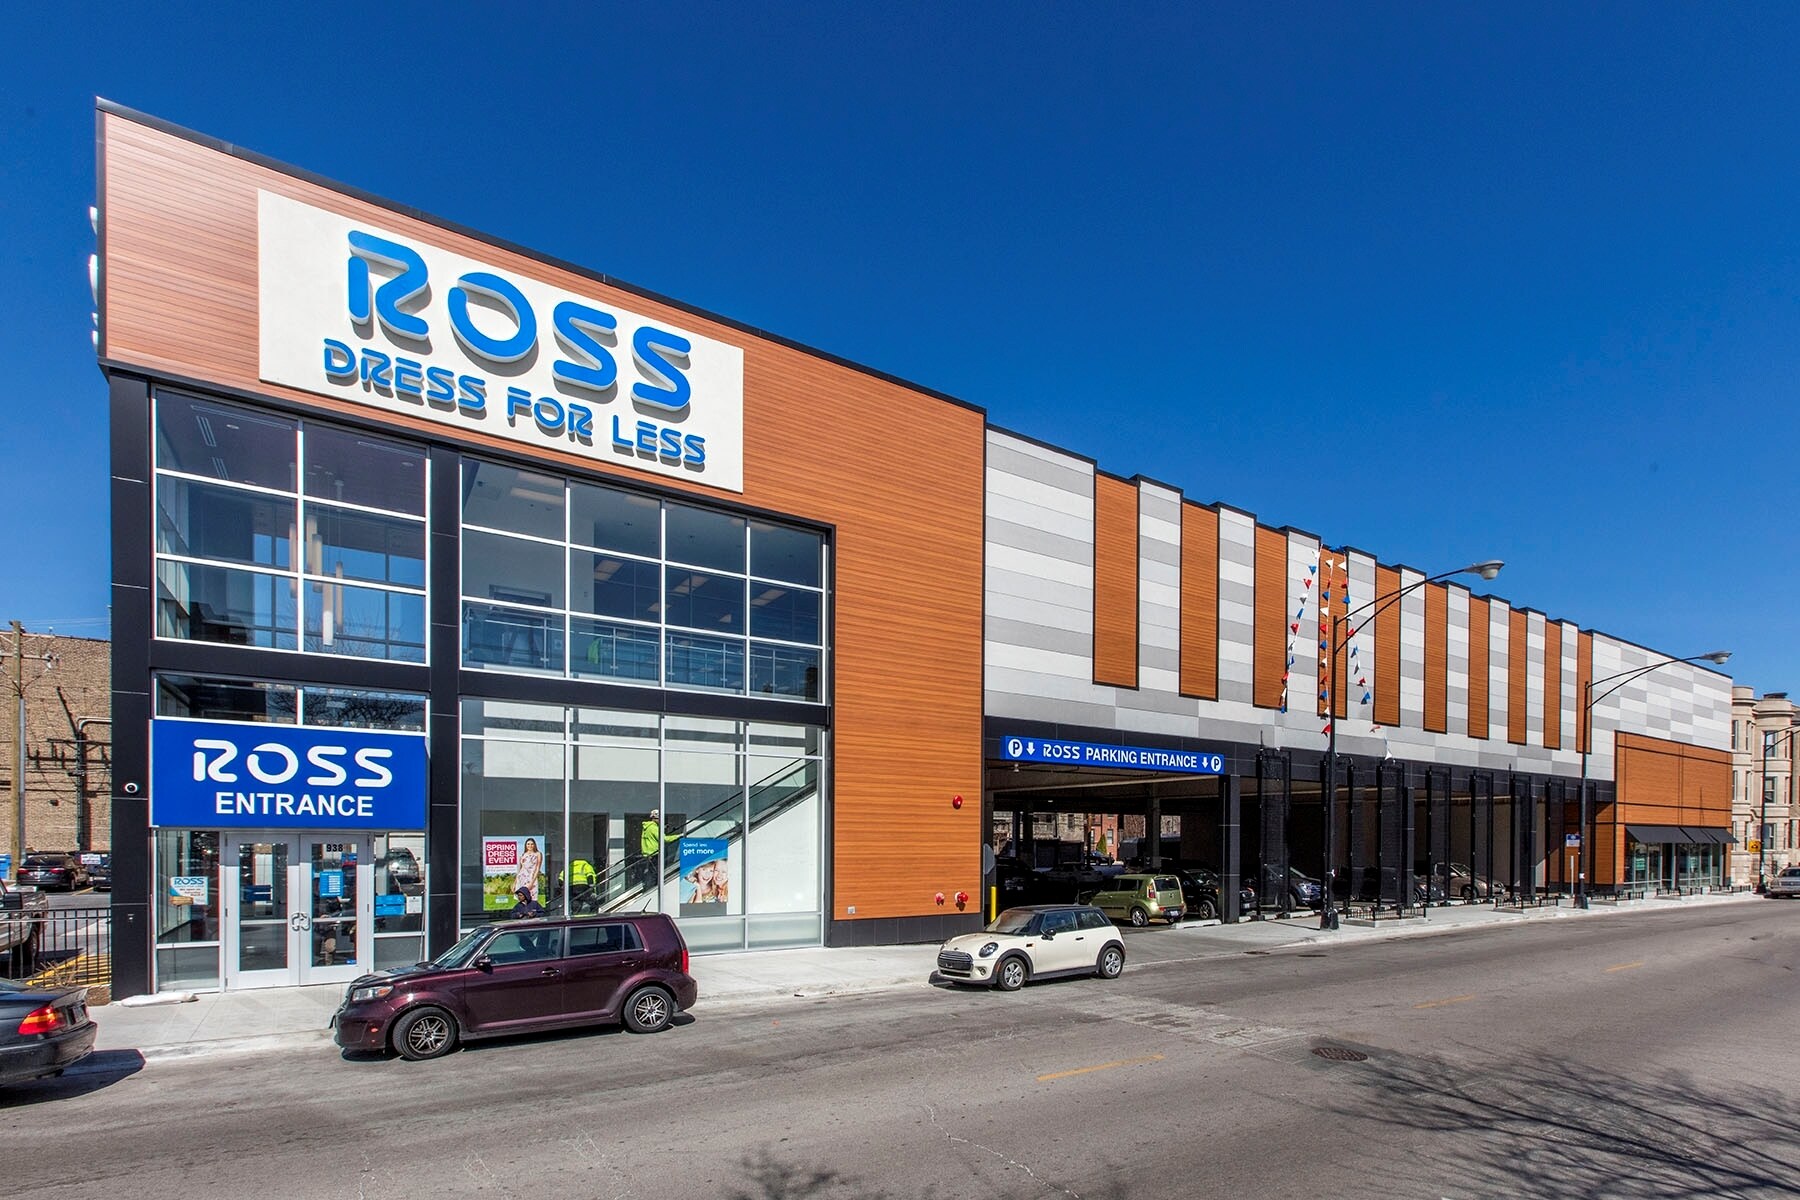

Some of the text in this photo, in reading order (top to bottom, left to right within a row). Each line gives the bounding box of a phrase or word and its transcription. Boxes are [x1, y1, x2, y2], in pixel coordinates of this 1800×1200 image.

[348, 230, 692, 411] ROSS
[324, 338, 705, 464] DRESS FOR LESS
[193, 739, 393, 788] ROSS
[1043, 743, 1081, 760] ROSS
[1085, 747, 1138, 764] PARKING
[1140, 752, 1198, 768] ENTRANCE
[215, 791, 374, 817] ENTRANCE
[326, 844, 344, 852] 938
[683, 848, 695, 856] get
[174, 877, 205, 885] ROSS
